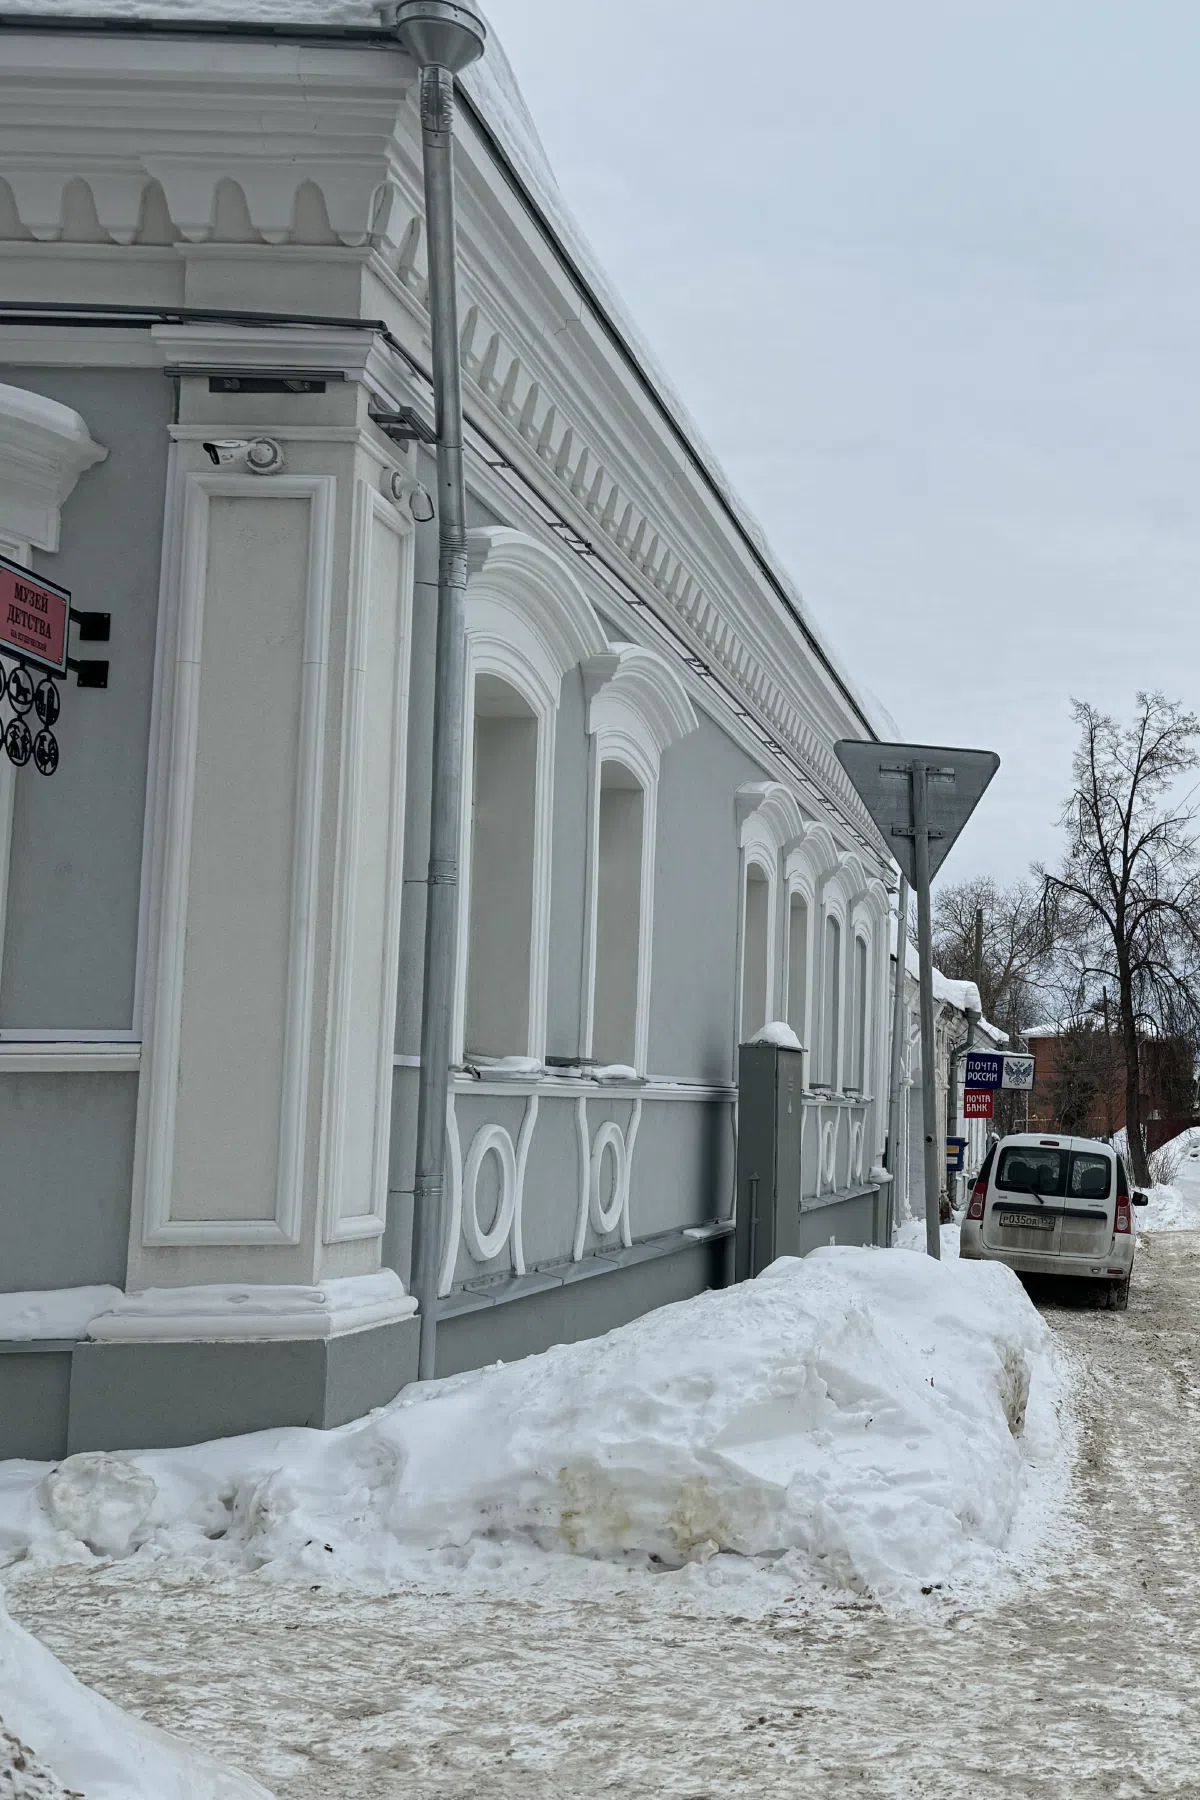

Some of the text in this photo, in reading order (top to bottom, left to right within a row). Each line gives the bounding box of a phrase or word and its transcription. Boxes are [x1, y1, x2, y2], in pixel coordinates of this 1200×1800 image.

[14, 582, 48, 614] МУЗЕЙ
[7, 603, 51, 639] ДЕТСТВА
[968, 1061, 998, 1071] ПОЧТА
[967, 1072, 998, 1082] РОССИИ
[966, 1095, 991, 1103] ПОЧТА
[966, 1103, 988, 1112] БАНК
